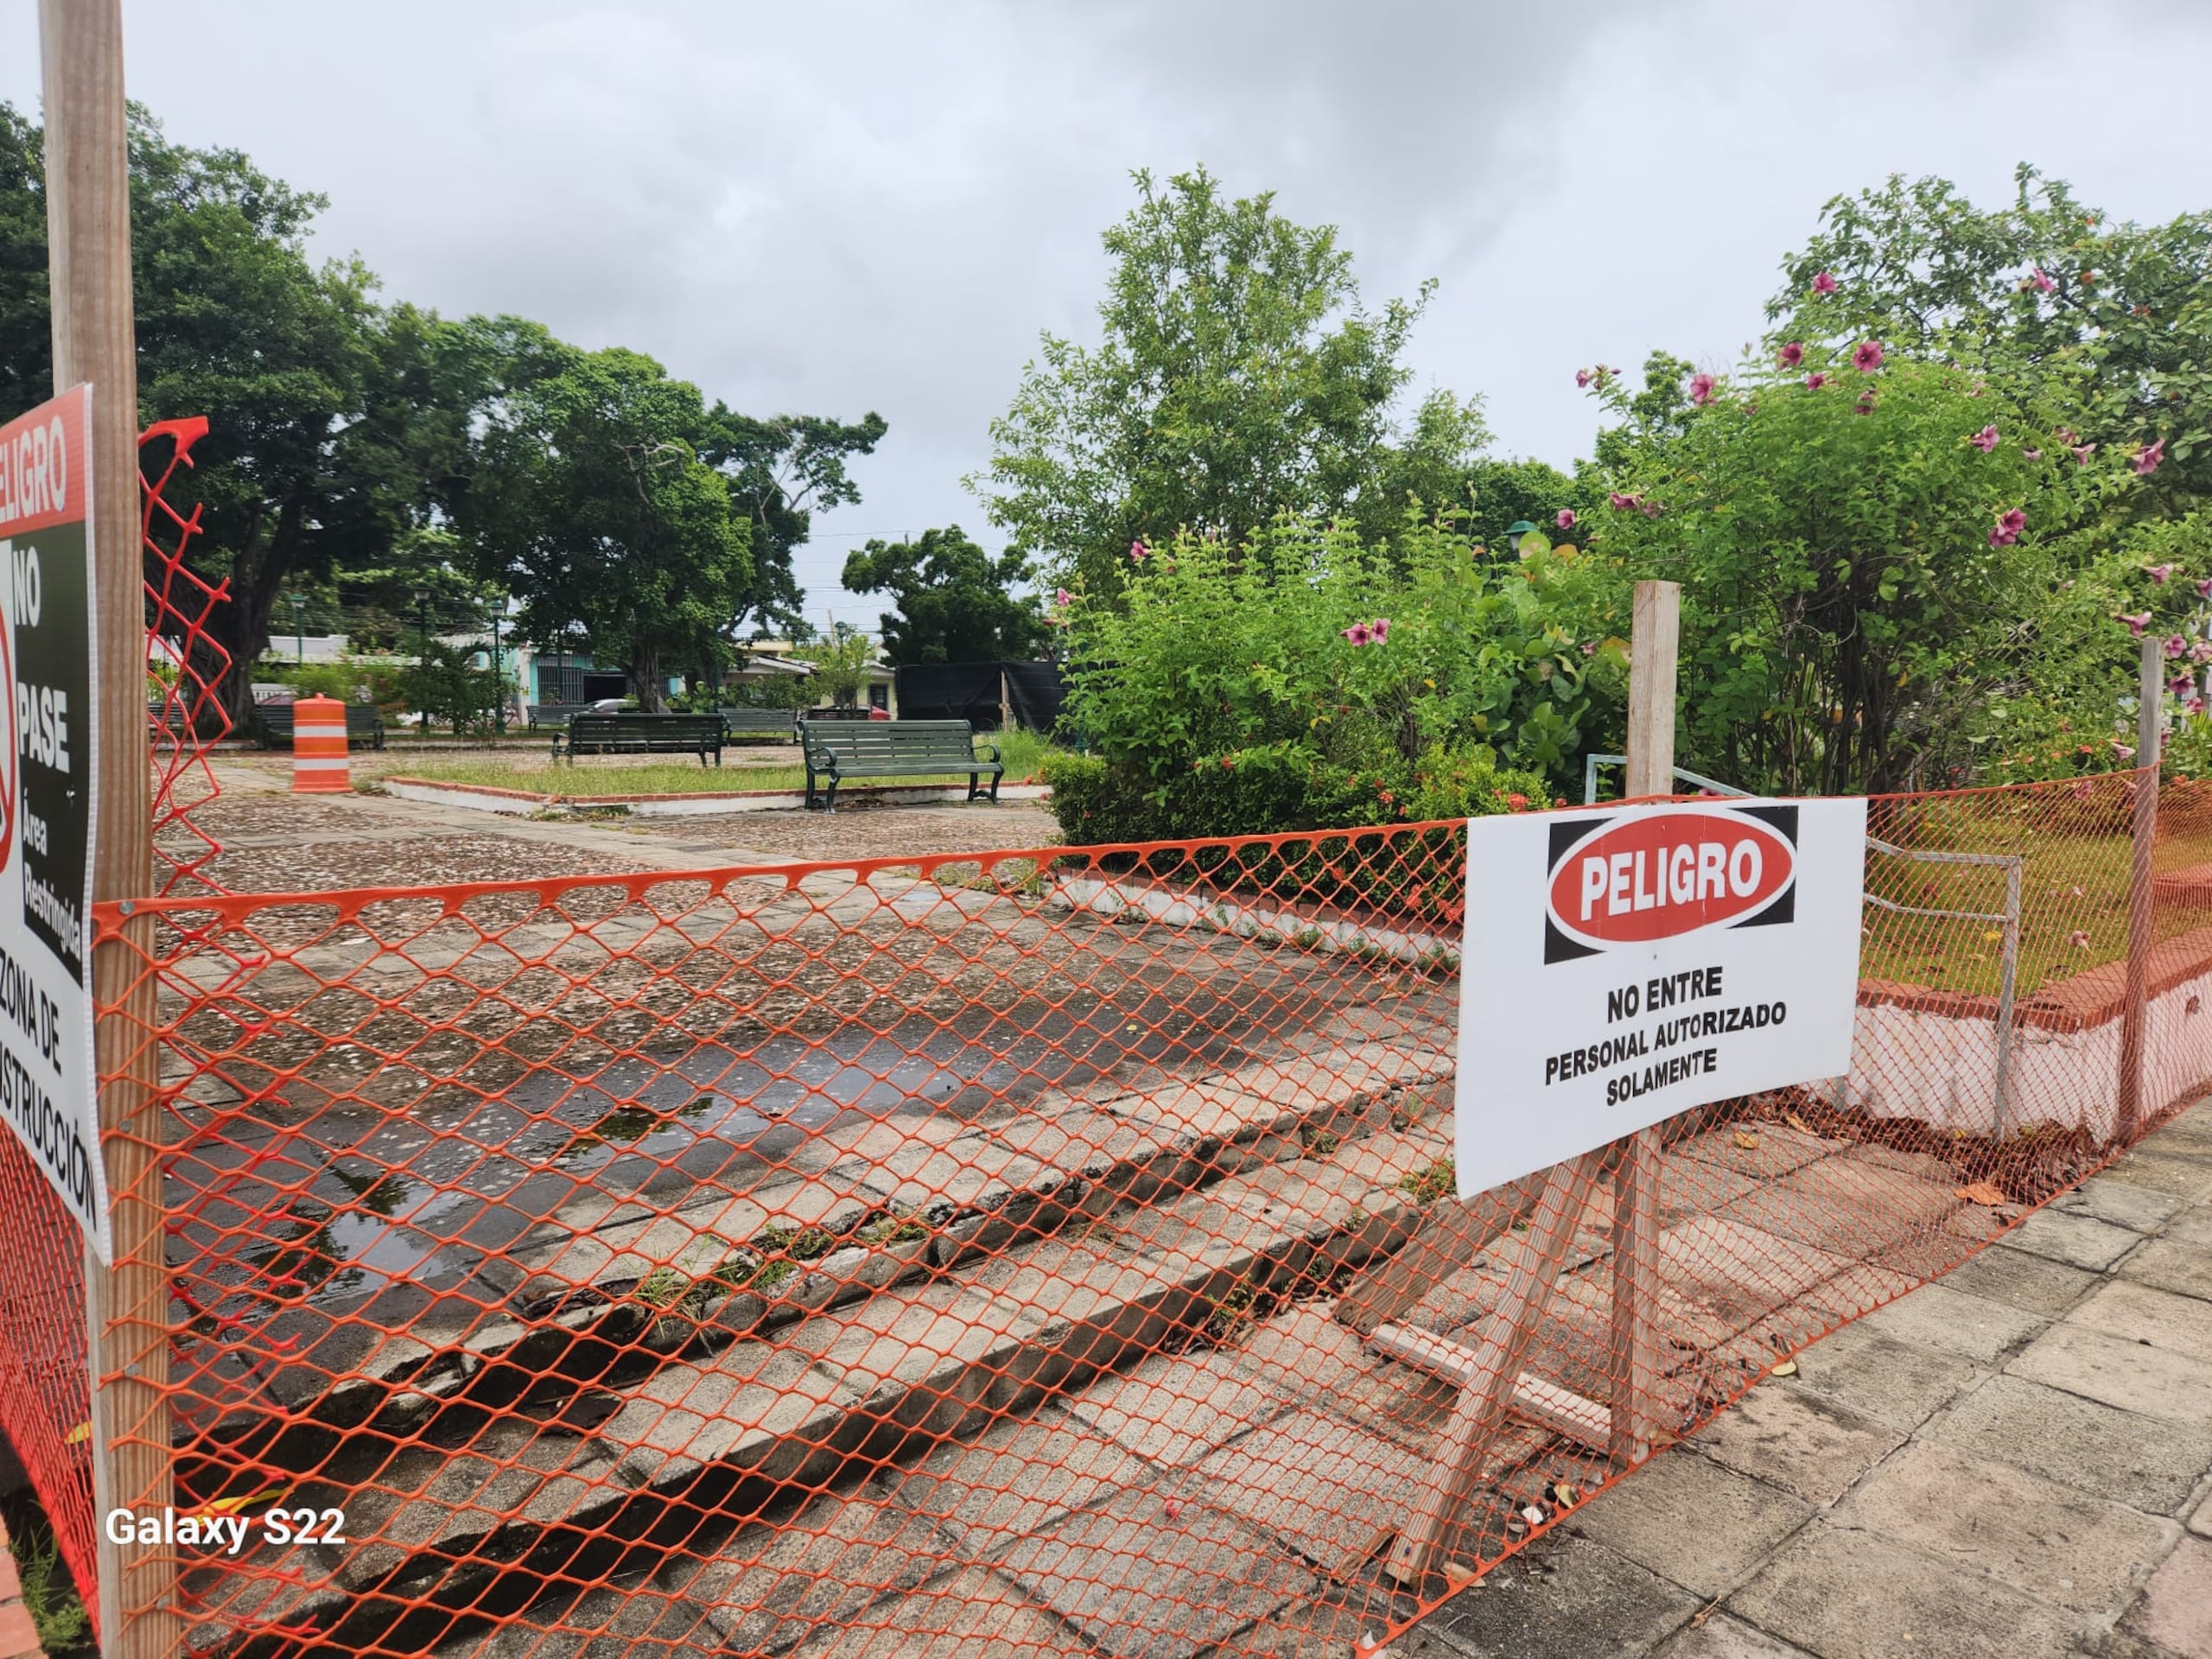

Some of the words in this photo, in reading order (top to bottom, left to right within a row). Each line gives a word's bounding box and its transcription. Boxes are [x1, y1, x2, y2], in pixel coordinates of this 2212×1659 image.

[13, 546, 41, 627] NO
[17, 682, 70, 773] PASE
[23, 787, 47, 856] Área
[24, 861, 81, 962] Restringida
[1580, 838, 1763, 921] PELIGRO
[41, 989, 61, 1077] DE
[1607, 985, 1640, 1023] NO
[1647, 966, 1724, 1012] ENTRE
[1545, 1031, 1649, 1086] PERSONAL
[1654, 1001, 1787, 1052] AUTORIZADO
[1606, 1048, 1717, 1107] SOLAMENTE
[0, 1040, 97, 1233] STRUCCIÓN
